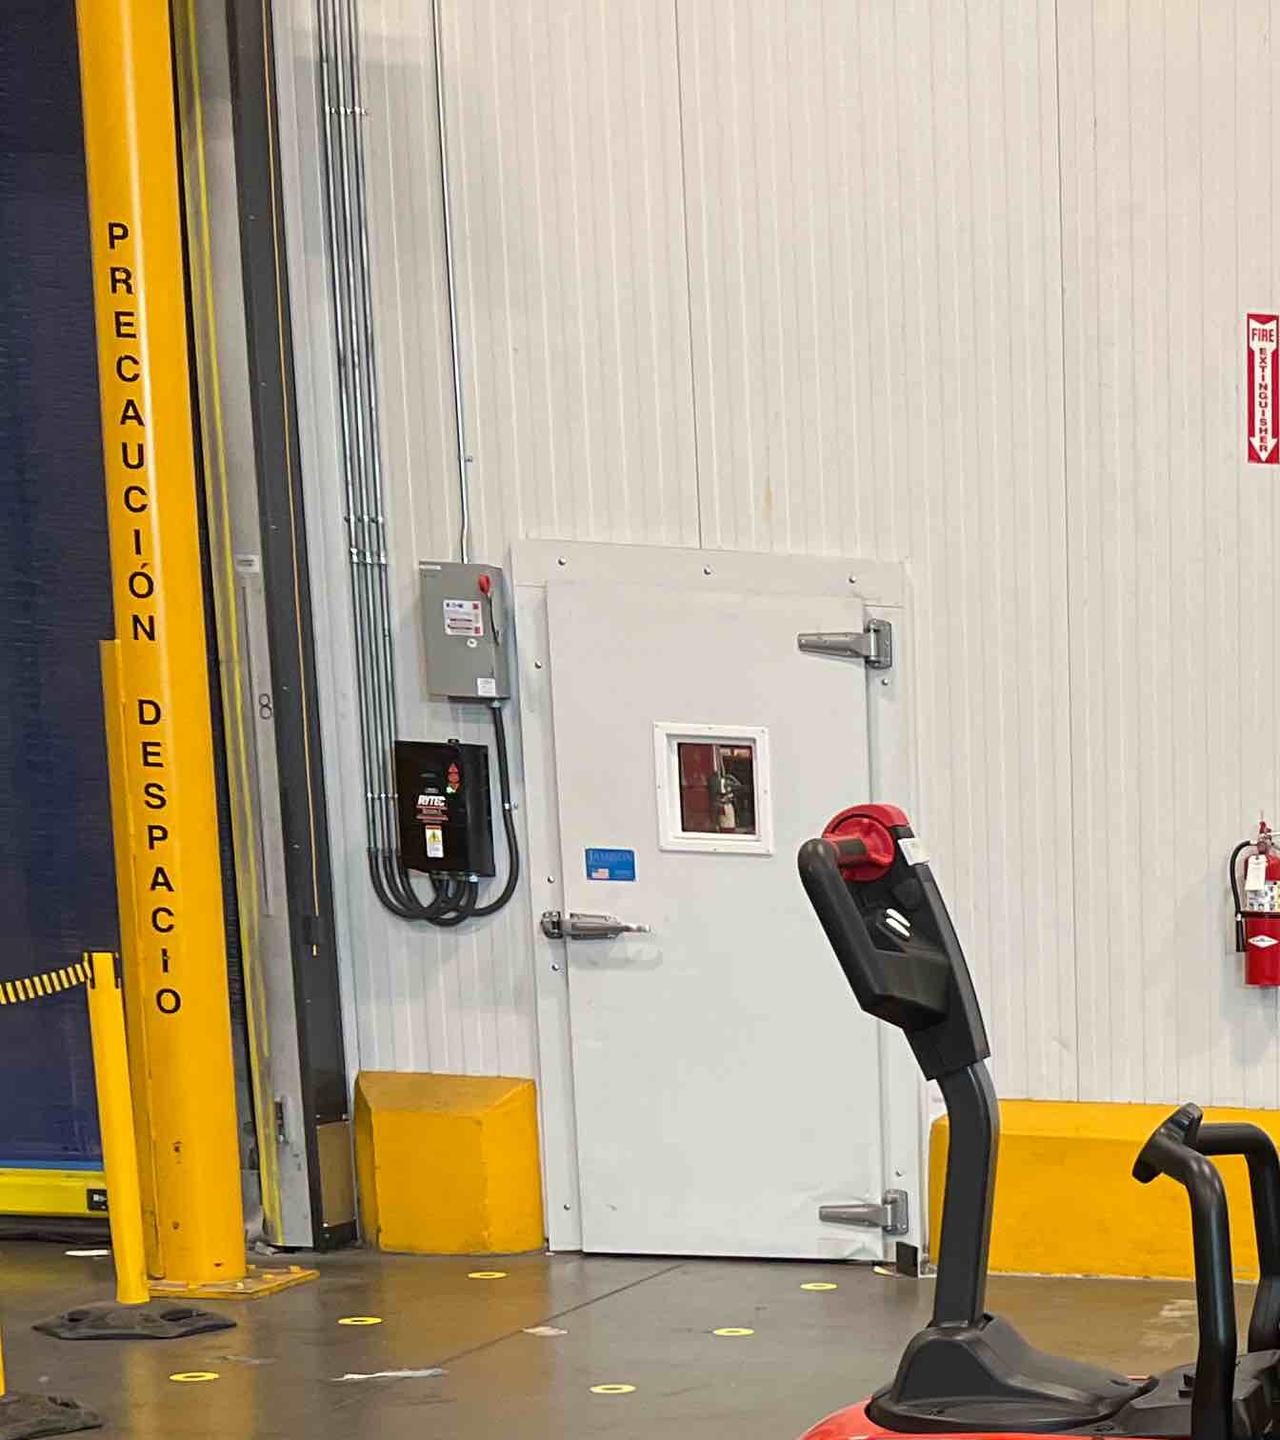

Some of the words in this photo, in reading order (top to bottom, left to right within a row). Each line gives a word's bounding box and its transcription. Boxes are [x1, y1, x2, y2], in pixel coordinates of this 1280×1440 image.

[1251, 328, 1275, 343] FIRE
[1259, 347, 1268, 452] EXTINGUISHER
[107, 222, 156, 641] PRECAUCIÓN
[137, 699, 182, 1014] DESPACIO
